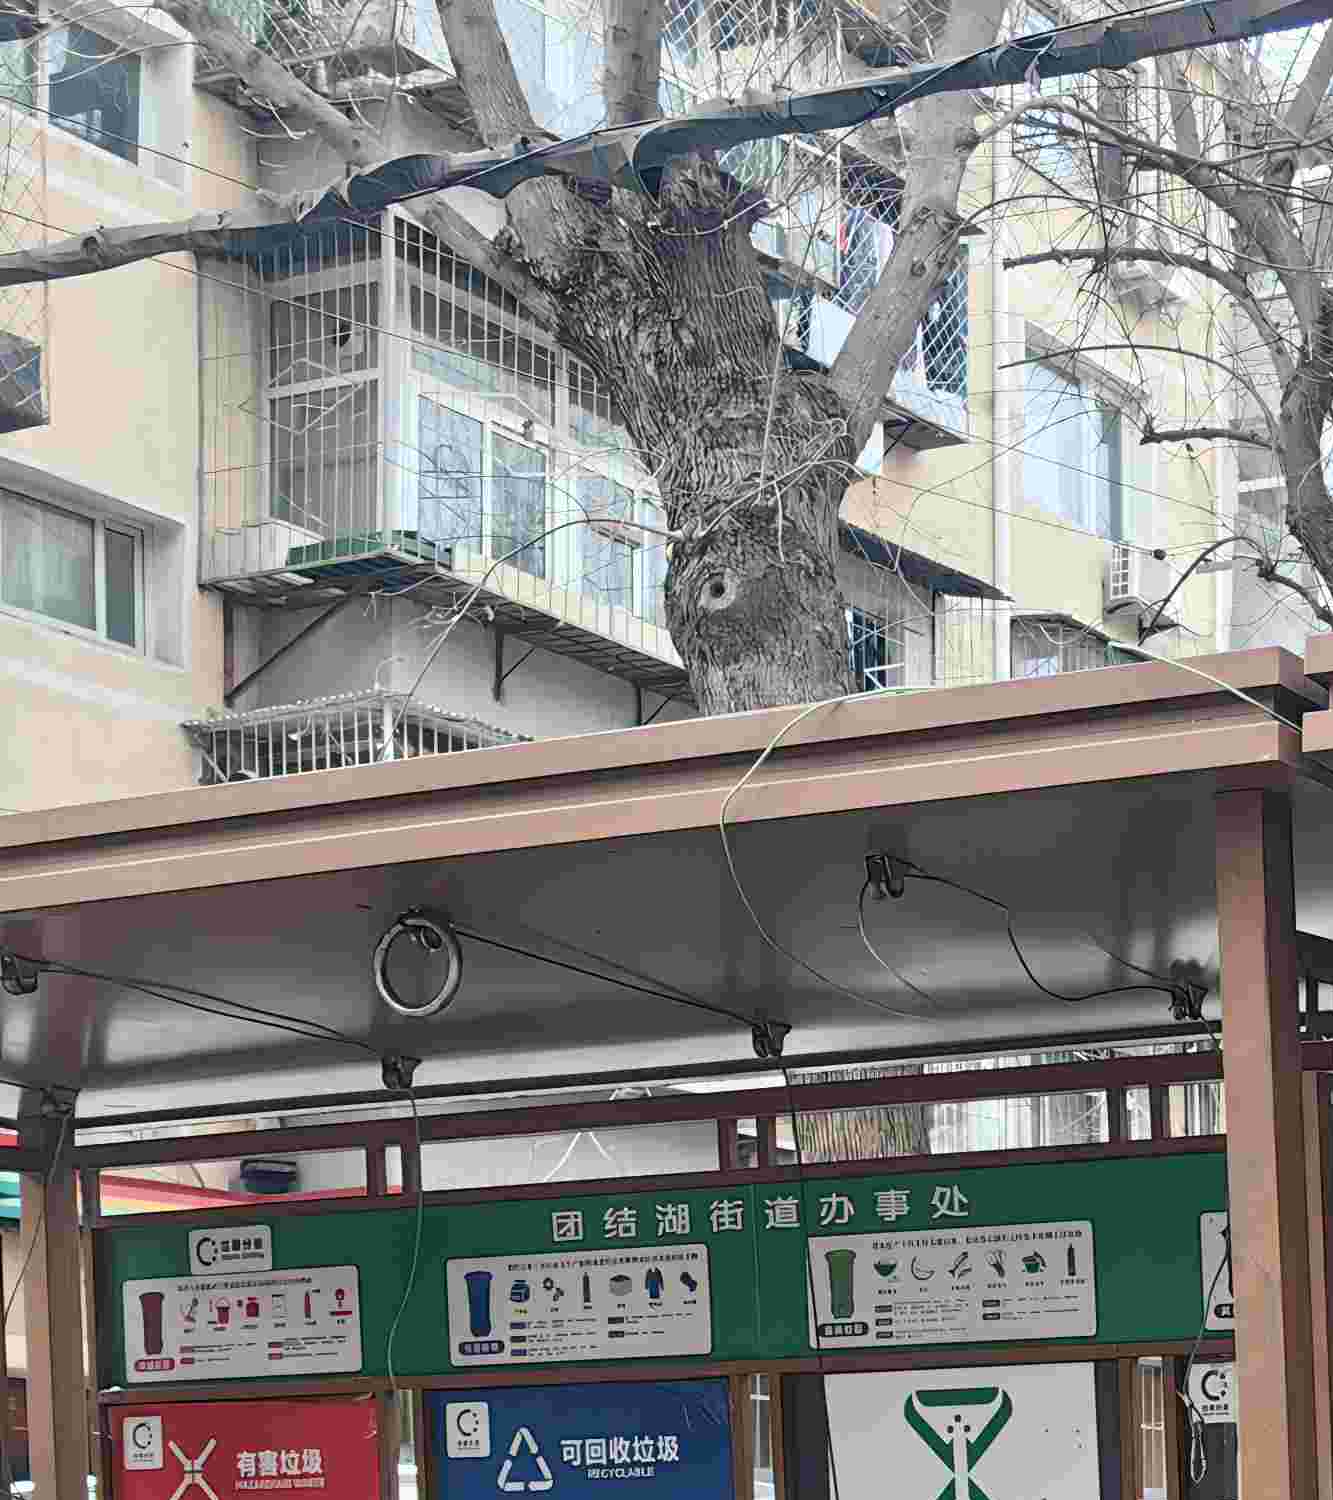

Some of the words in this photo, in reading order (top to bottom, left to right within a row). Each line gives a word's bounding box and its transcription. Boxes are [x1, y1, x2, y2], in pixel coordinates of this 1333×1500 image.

[551, 1184, 969, 1242] 团结湖街道办事处
[559, 1436, 680, 1466] 可回收垃圾
